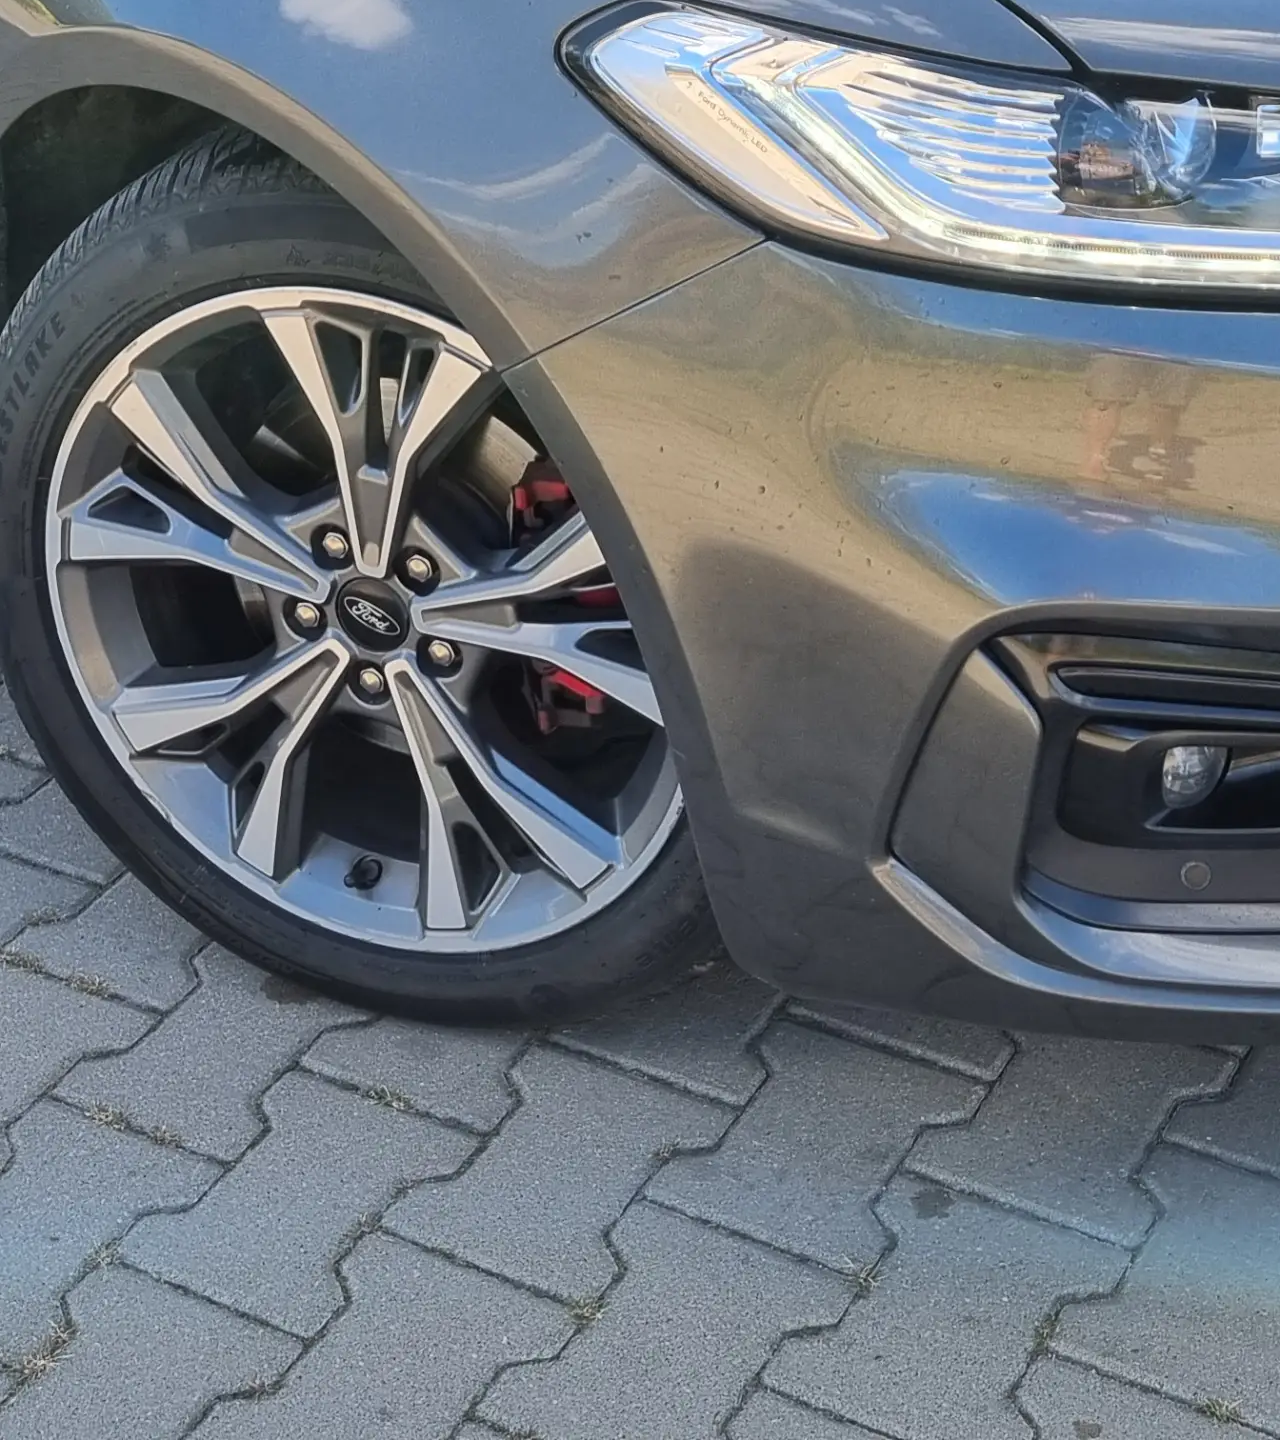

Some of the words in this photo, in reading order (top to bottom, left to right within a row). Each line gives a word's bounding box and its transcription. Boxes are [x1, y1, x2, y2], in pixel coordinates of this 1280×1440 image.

[698, 91, 717, 110] Ford
[717, 108, 750, 138] Dynamic
[750, 137, 769, 154] LED
[351, 601, 391, 631] Ford
